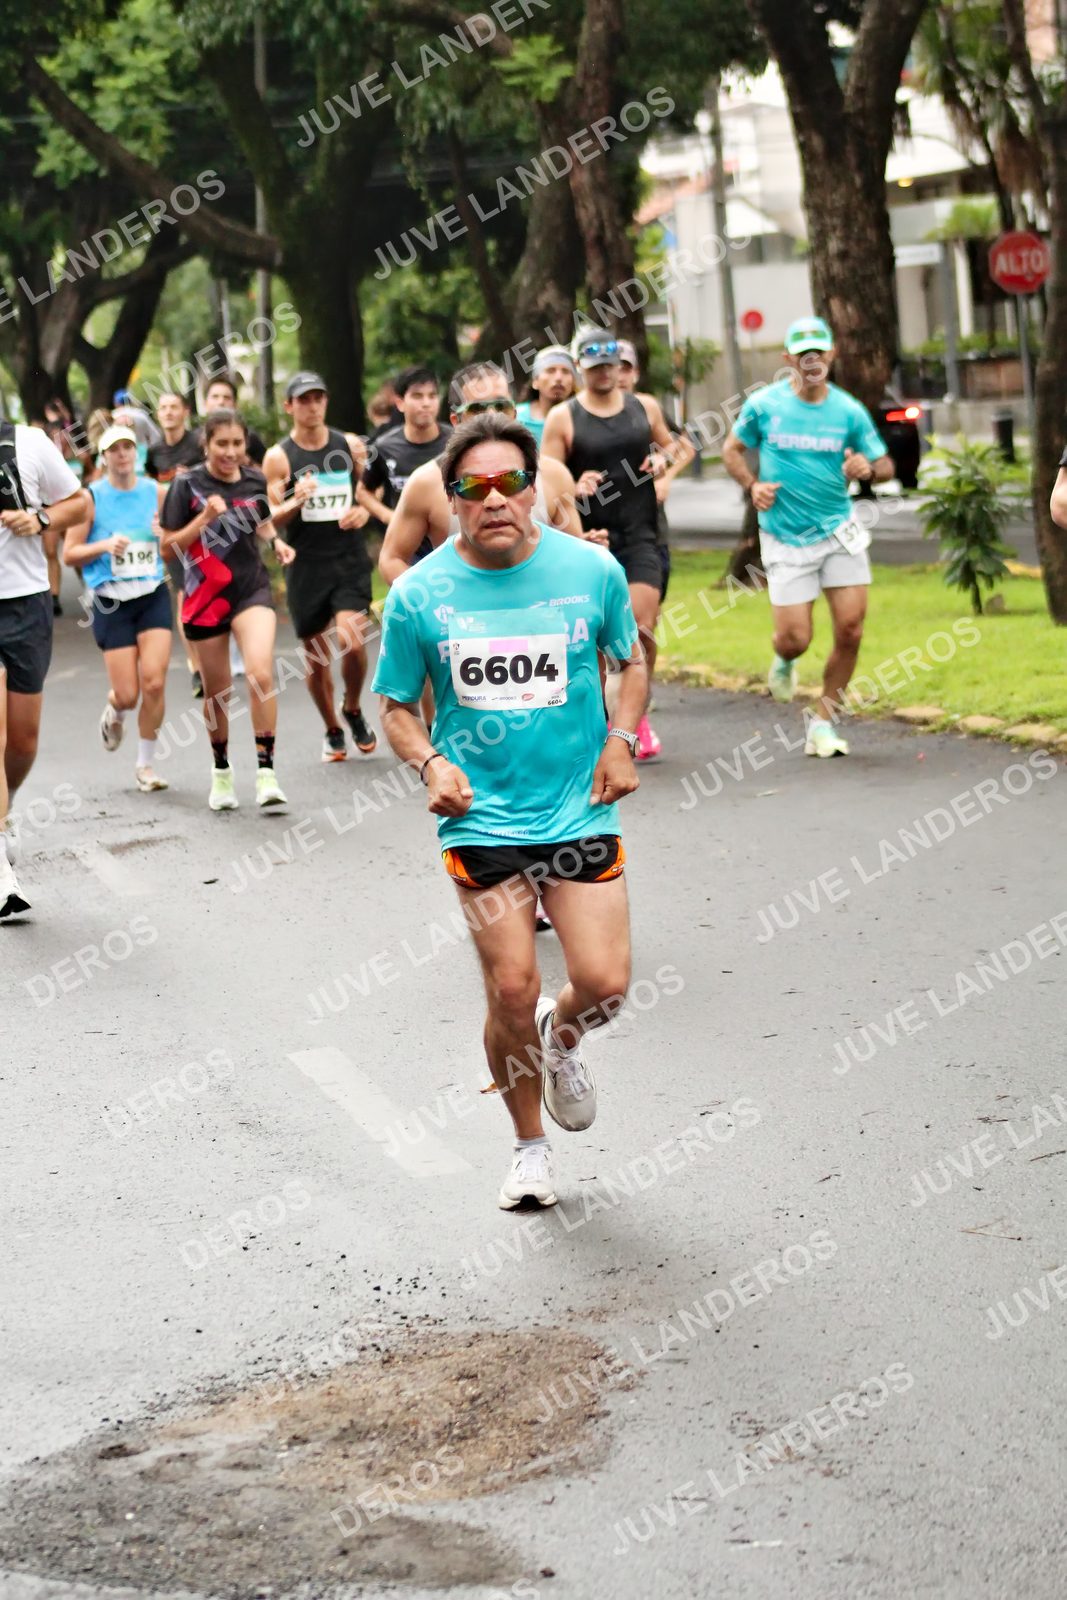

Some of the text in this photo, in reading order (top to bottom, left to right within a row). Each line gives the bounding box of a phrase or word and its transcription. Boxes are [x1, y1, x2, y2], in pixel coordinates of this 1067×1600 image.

[995, 248, 1044, 275] ALTO
[549, 594, 591, 607] BROOKS
[459, 653, 559, 687] 6604
